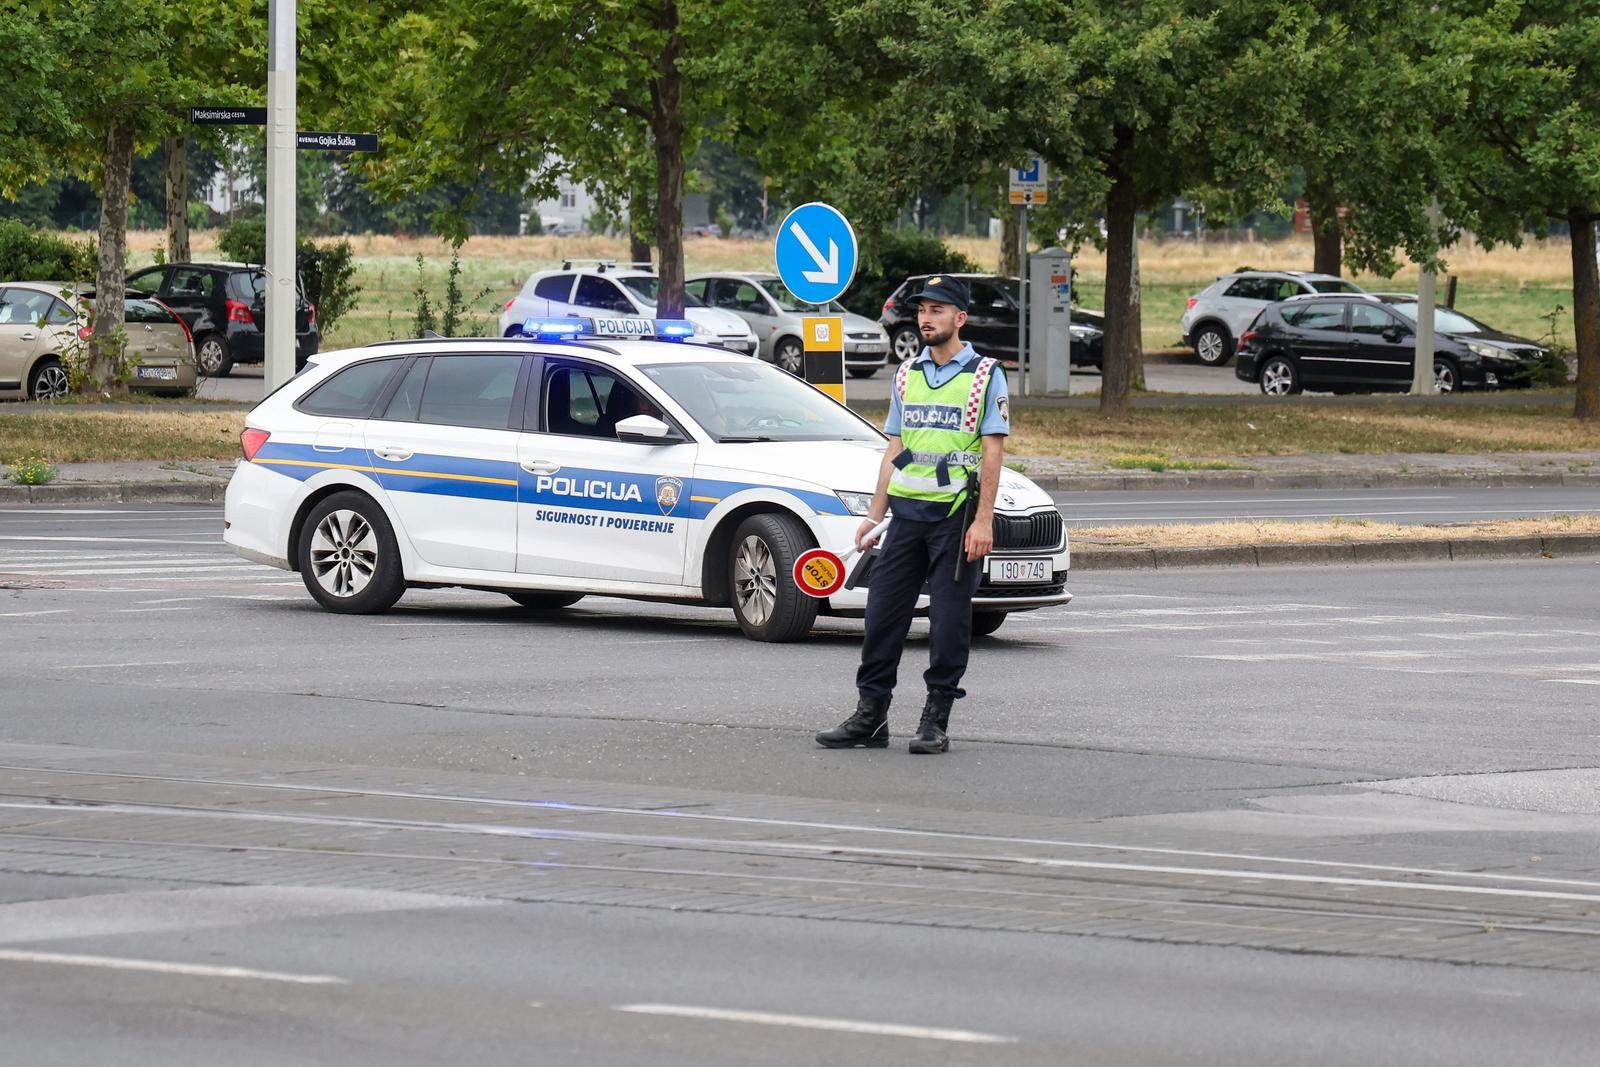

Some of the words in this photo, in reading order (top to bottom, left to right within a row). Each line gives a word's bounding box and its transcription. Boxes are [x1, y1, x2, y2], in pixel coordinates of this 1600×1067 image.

[194, 110, 231, 120] Maksimirska
[319, 136, 336, 147] Gojka
[337, 135, 356, 146] Šuška
[600, 319, 651, 334] POLICIJA
[904, 410, 958, 425] POLICIJA
[536, 475, 642, 503] POLICIJA
[535, 510, 598, 527] SIGURNOST
[599, 516, 606, 527] I
[606, 517, 675, 534] POVJERENJE
[805, 564, 829, 588] STOP
[1001, 562, 1019, 579] 190
[1027, 562, 1044, 579] 749
